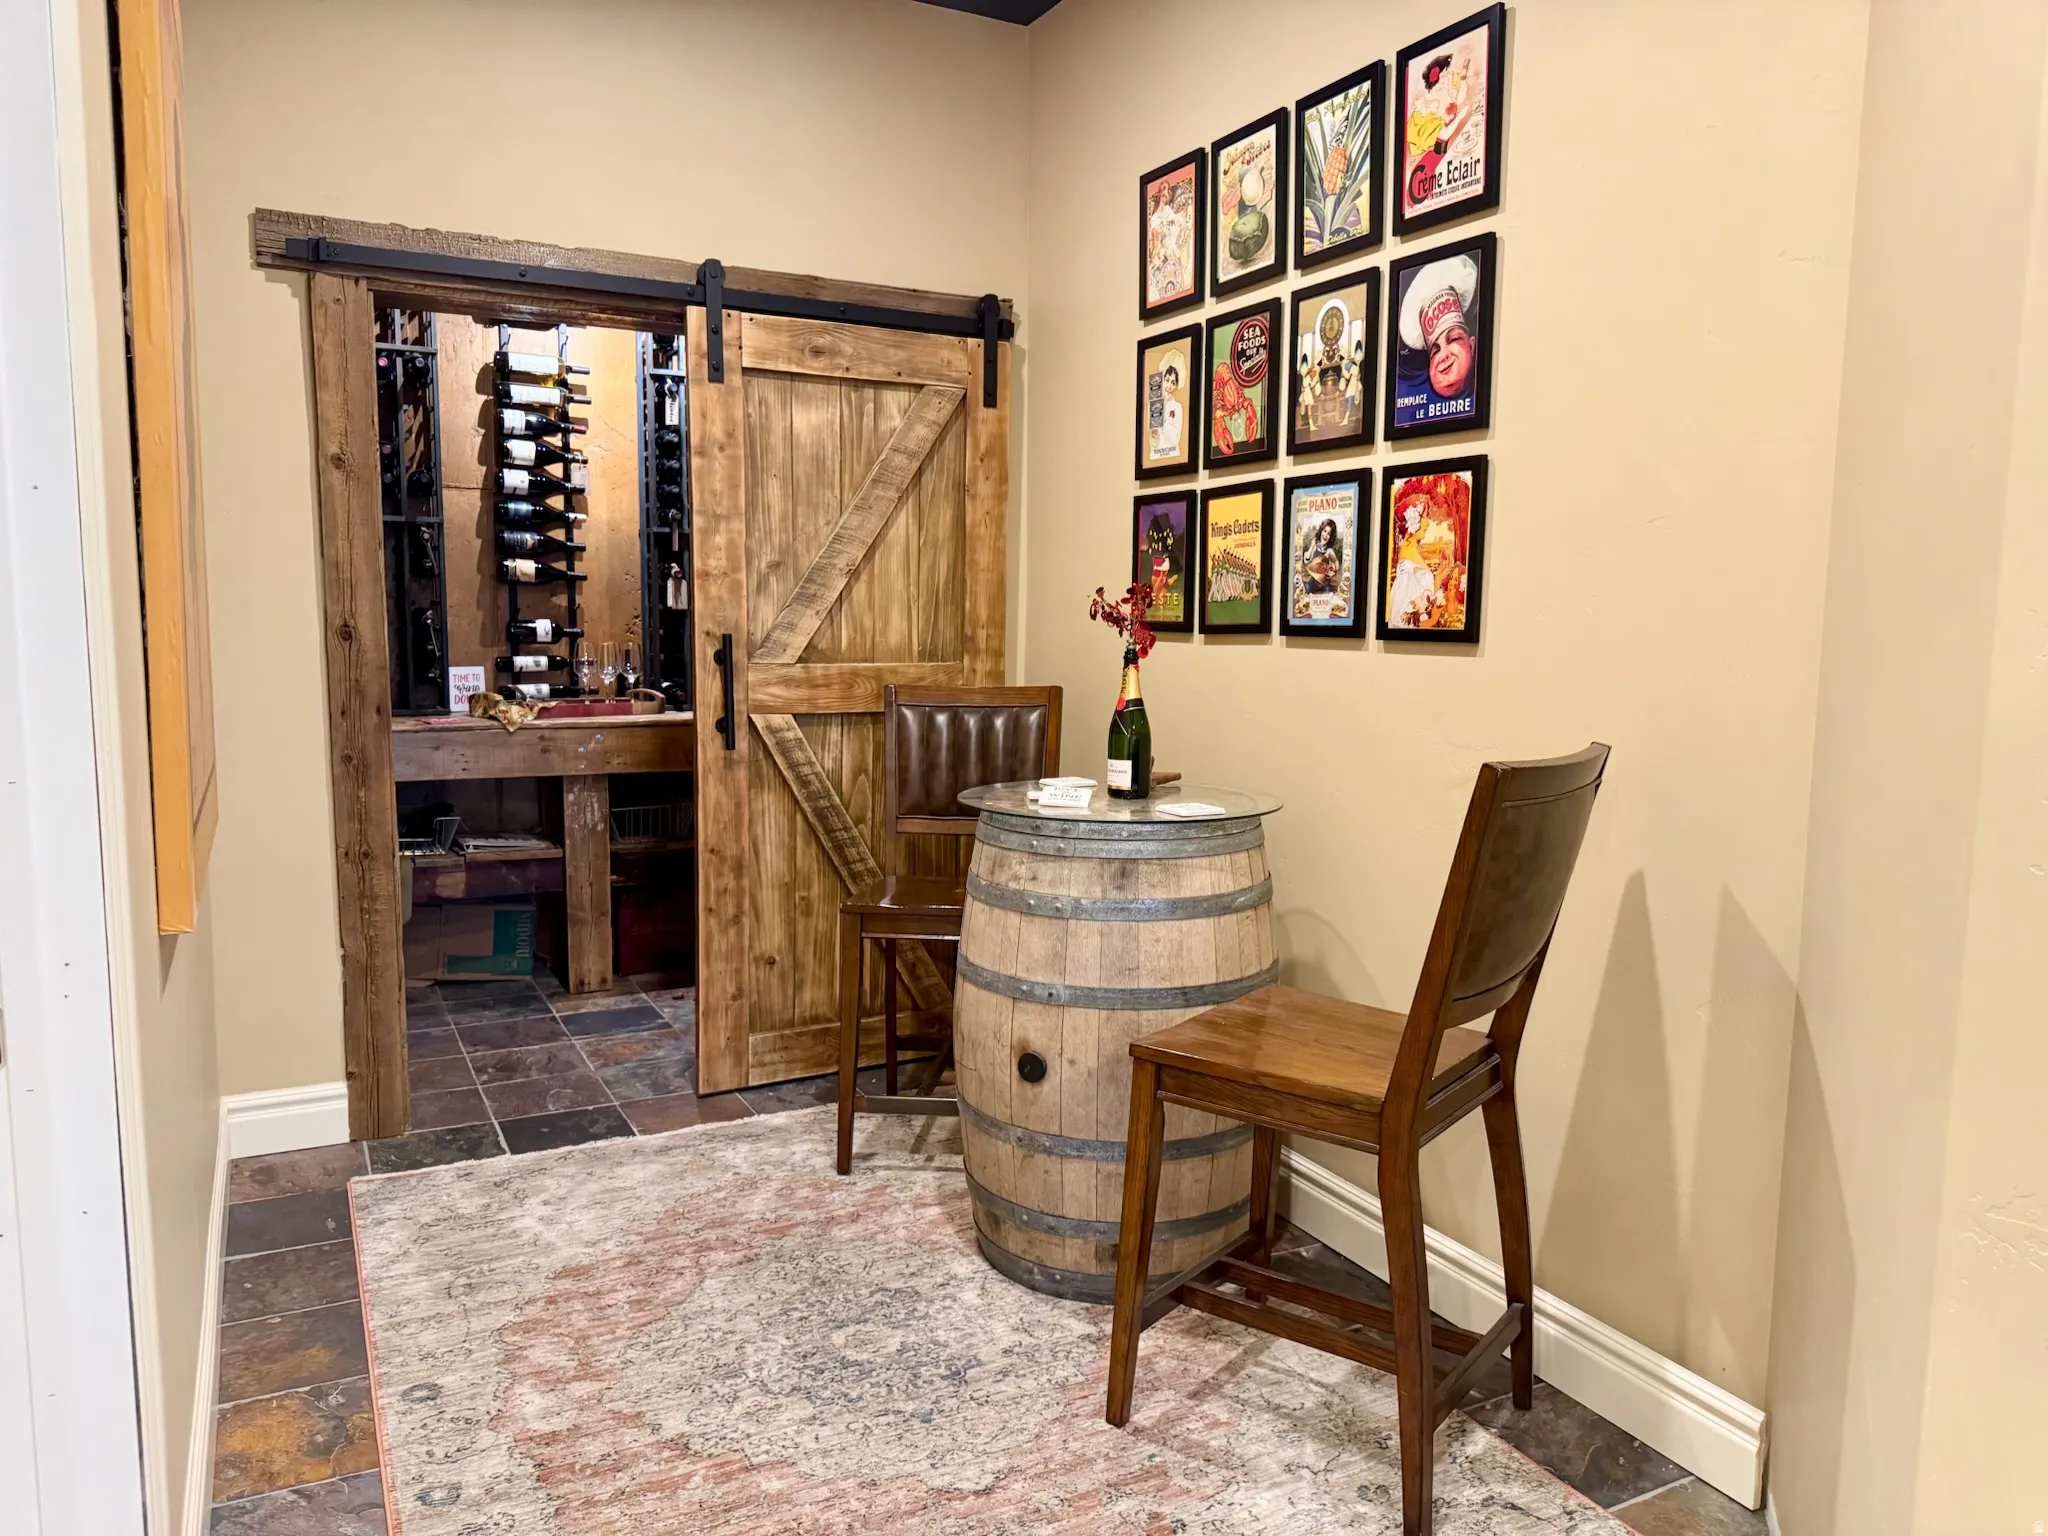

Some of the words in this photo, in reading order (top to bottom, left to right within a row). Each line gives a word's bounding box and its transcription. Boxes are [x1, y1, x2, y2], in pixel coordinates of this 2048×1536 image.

[1446, 156, 1481, 186] Eclair
[1243, 325, 1261, 340] SEA
[1237, 335, 1267, 352] FOODS
[1396, 393, 1428, 408] REMPLACE
[1415, 409, 1425, 419] LE
[1428, 398, 1472, 417] BEURRE
[1309, 497, 1338, 512] PLANO
[1233, 518, 1260, 535] Cadets
[452, 673, 471, 684] TIME
[472, 672, 481, 683] TO
[454, 693, 470, 705] DO
[515, 911, 532, 958] MIDORI
